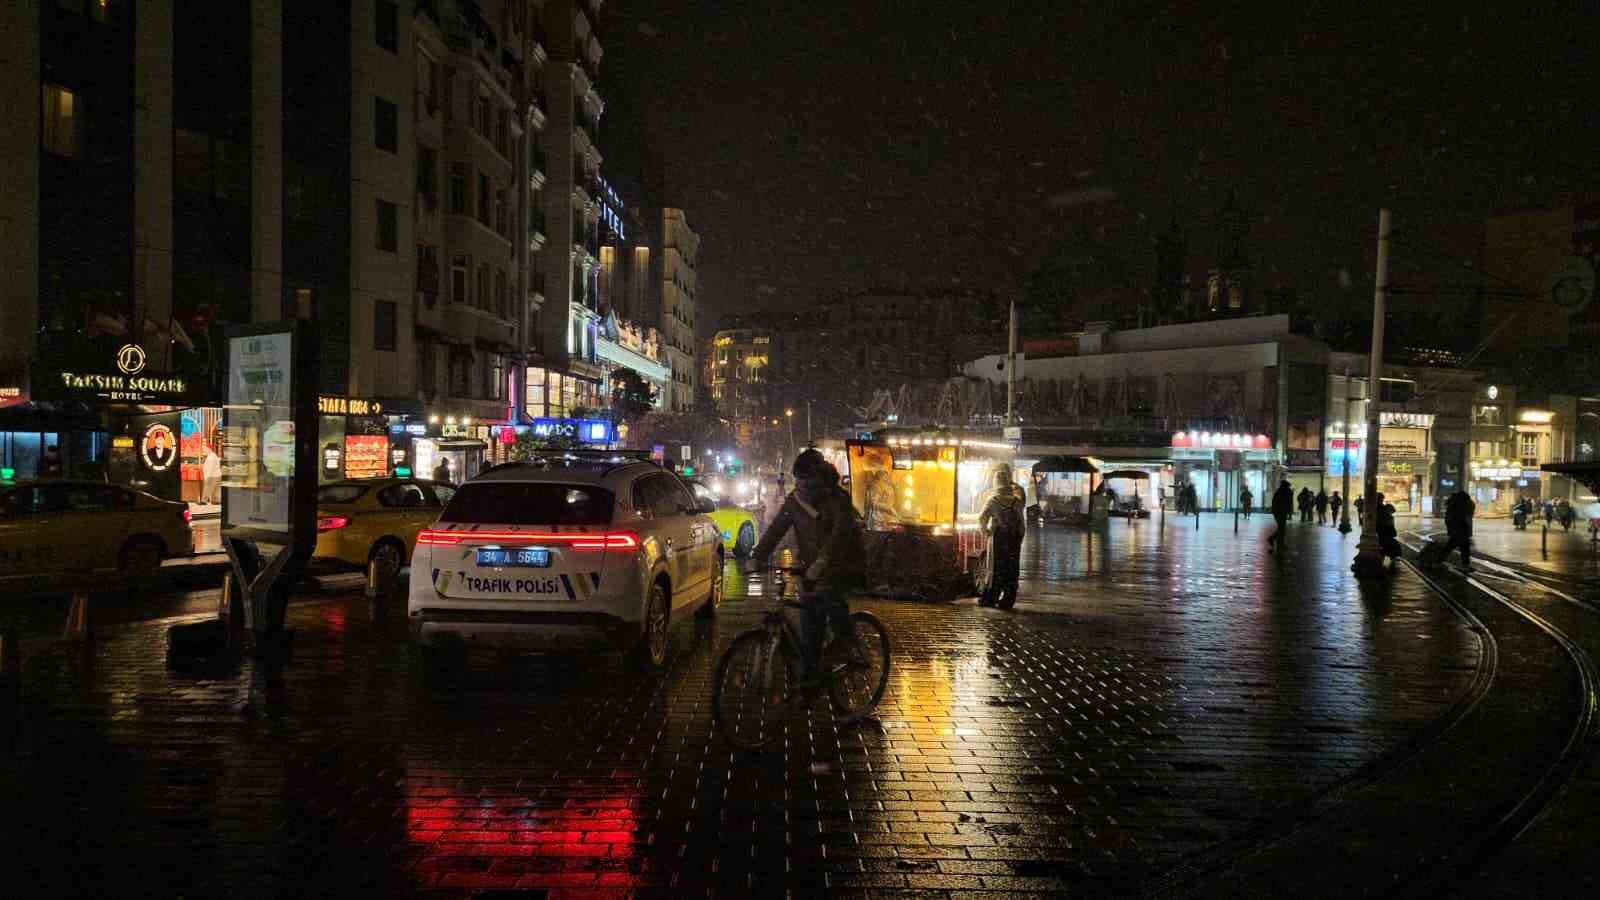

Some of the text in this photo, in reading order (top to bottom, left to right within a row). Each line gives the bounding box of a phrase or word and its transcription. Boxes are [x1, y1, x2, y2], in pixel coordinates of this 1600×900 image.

[62, 372, 186, 393] TAKSIM SQUARE
[111, 391, 142, 400] HOTEL
[535, 423, 574, 436] MADO
[484, 551, 496, 563] 34
[503, 551, 512, 563] A
